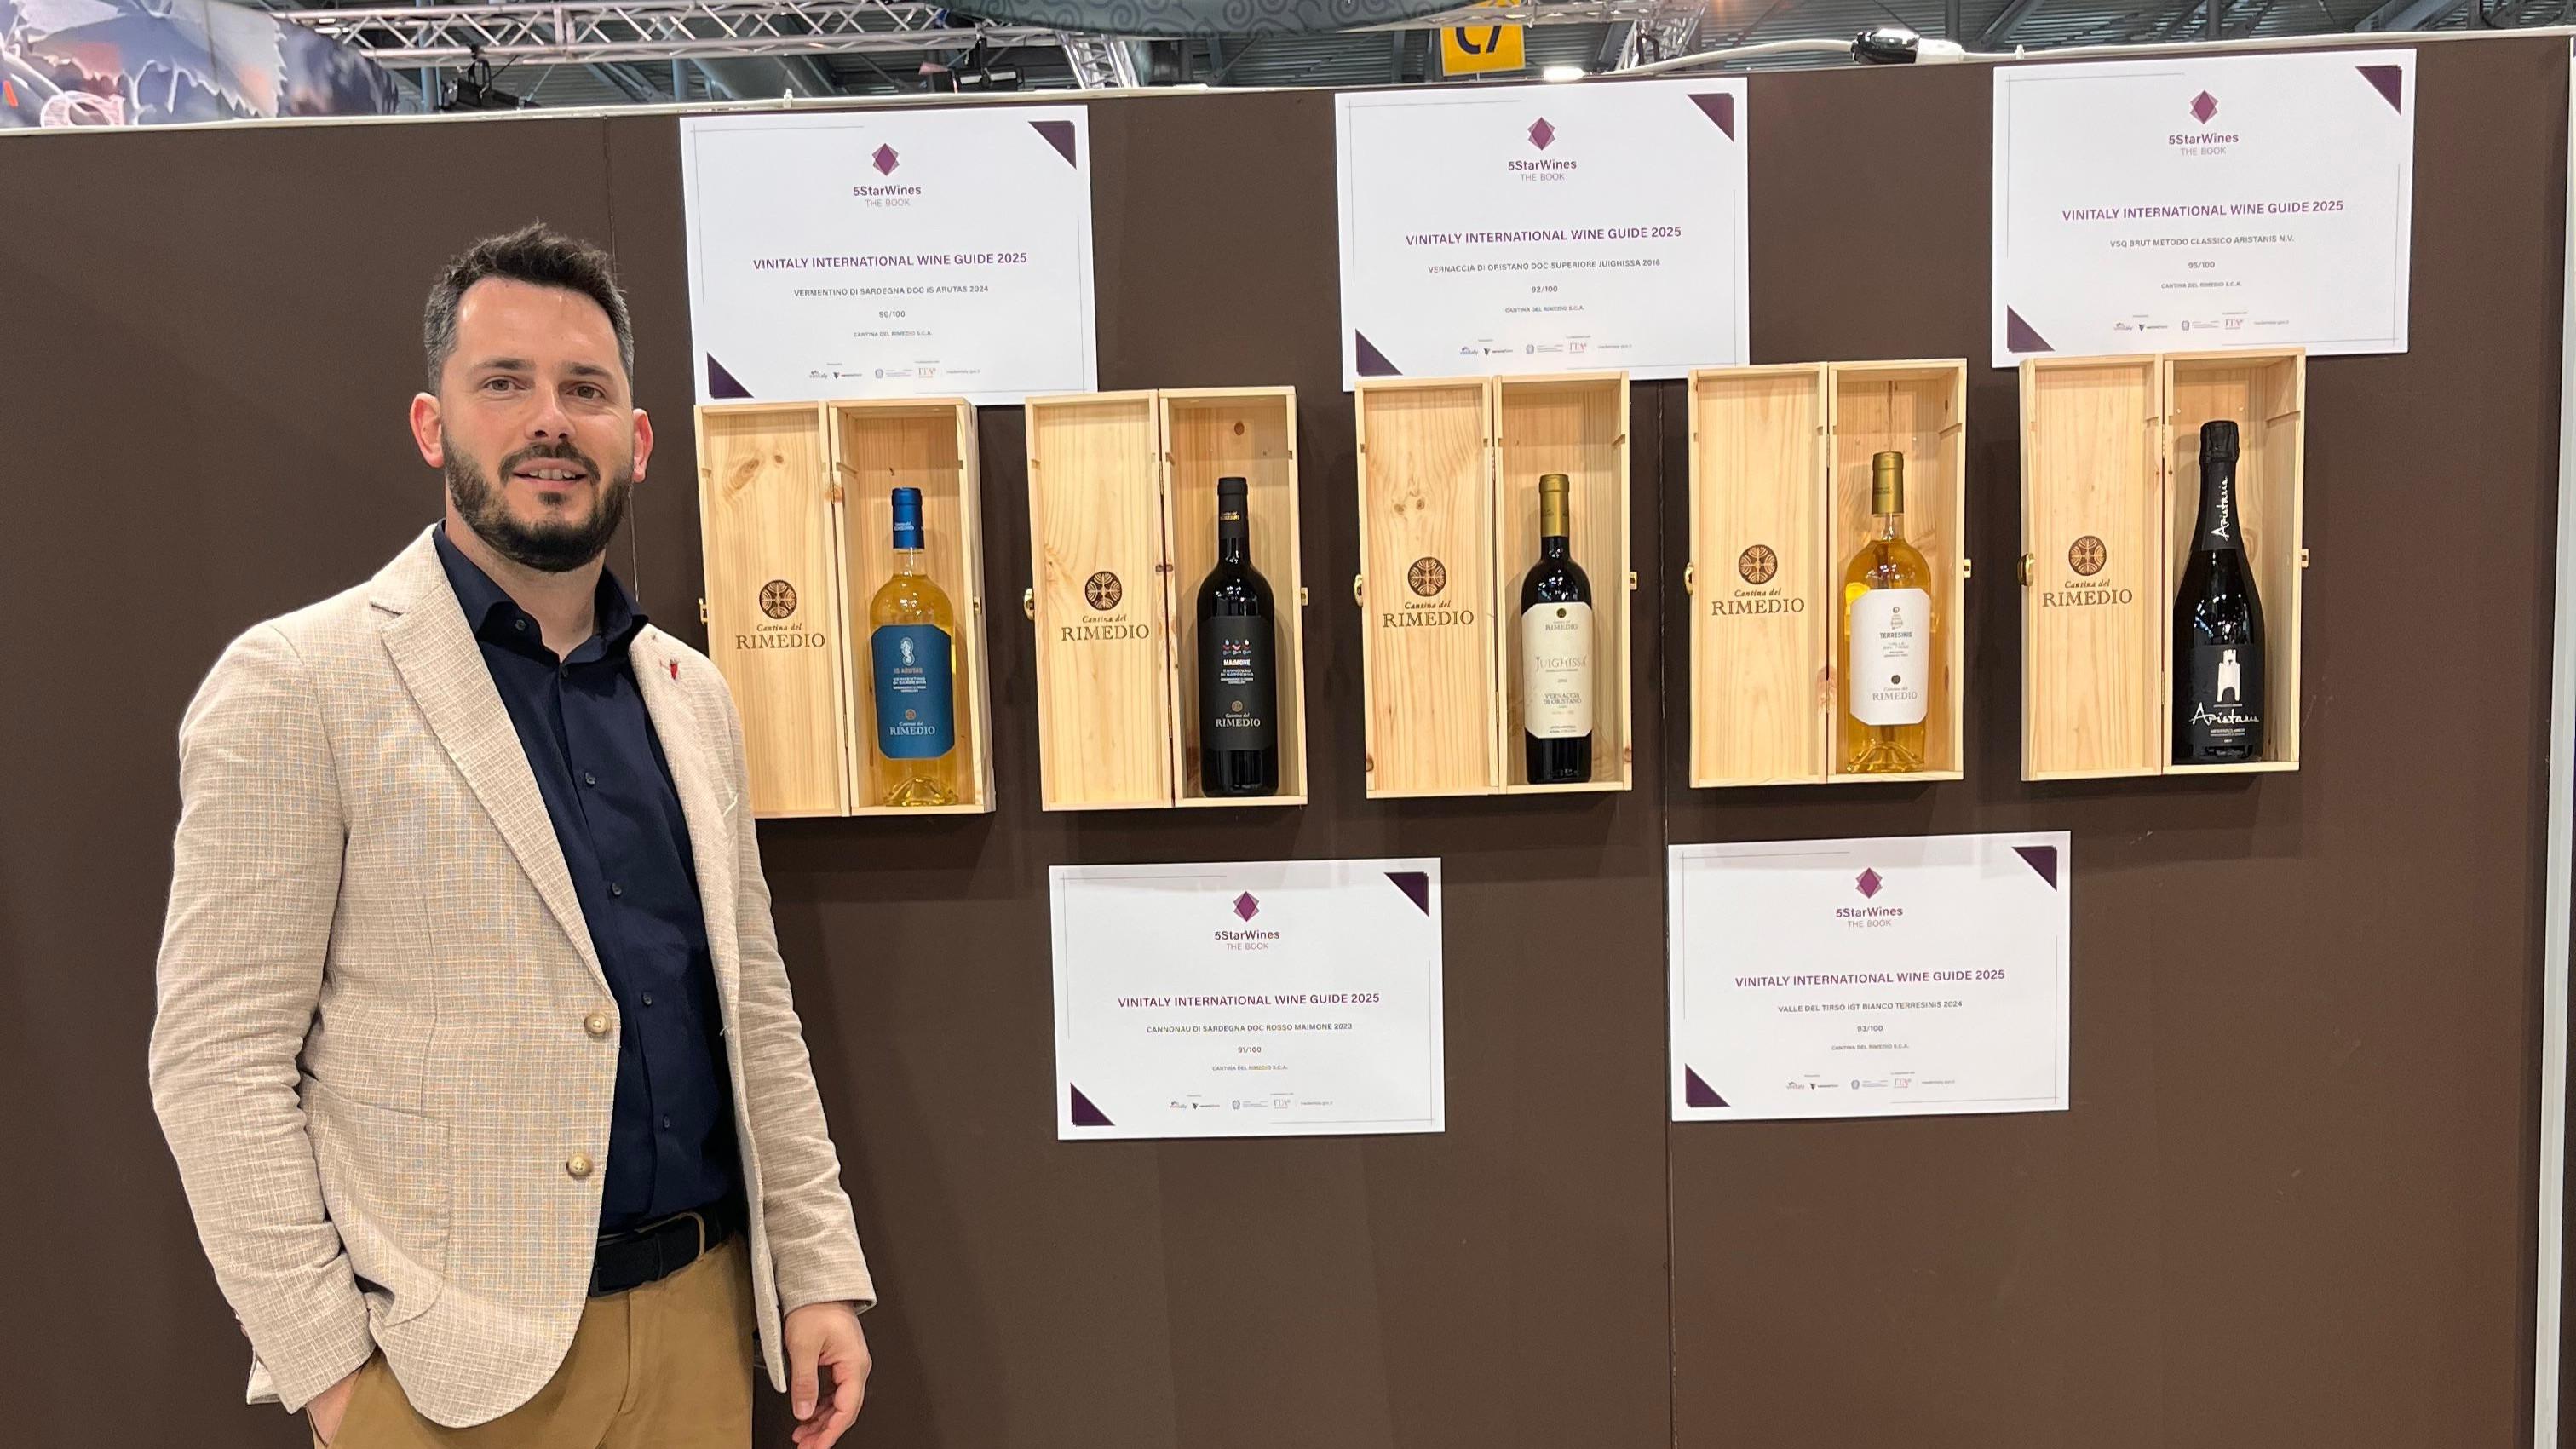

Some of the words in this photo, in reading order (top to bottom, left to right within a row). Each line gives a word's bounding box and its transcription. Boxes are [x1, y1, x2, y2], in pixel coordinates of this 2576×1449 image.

[2168, 133, 2240, 145] 5StarWines
[2180, 147, 2198, 157] THE
[2200, 146, 2227, 156] BOOK
[1508, 159, 1578, 171] 5StarWines
[1520, 173, 1537, 182] THE
[1539, 172, 1566, 181] BOOK
[853, 185, 922, 197] 5StarWines
[865, 198, 883, 208] THE
[885, 198, 911, 207] BOOK
[2061, 208, 2120, 221] VINITALY
[2123, 204, 2228, 219] INTERNATIONAL
[2230, 203, 2264, 216] WINE
[2268, 201, 2309, 214] GUIDE
[2312, 200, 2343, 212] 2025
[1406, 233, 1463, 246] VINITALY
[1465, 230, 1568, 244] INTERNATIONAL
[1570, 228, 1605, 240] WINE
[1607, 227, 1648, 239] GUIDE
[1651, 226, 1682, 238] 2025
[2109, 239, 2128, 249] VSQ
[2129, 239, 2152, 248] BRUT
[2153, 238, 2189, 246] METODO
[2190, 237, 2233, 245] CLASSICO
[2234, 234, 2277, 244] ARISTANIS
[2279, 234, 2295, 243] N.V.
[752, 258, 809, 270] VINITALY
[812, 256, 914, 268] INTERNATIONAL
[917, 254, 951, 266] WINE
[953, 253, 994, 265] GUIDE
[997, 252, 1027, 264] 2025
[1428, 264, 1475, 273] VERNACCIA
[1487, 262, 1529, 272] ORISTANO
[1531, 262, 1549, 270] DOC
[1550, 261, 1597, 269] SUPERIORE
[793, 288, 848, 297] VERMENTINO
[860, 287, 906, 296] SARDEGNA
[935, 285, 968, 294] ARUTAS
[2064, 580, 2096, 589] Cantina
[2098, 578, 2111, 587] del
[1734, 589, 1767, 597] Cantina
[1768, 587, 1782, 596] del
[2042, 589, 2133, 607] RIMEDIO
[1404, 601, 1436, 610] Cantina
[1438, 599, 1452, 608] del
[1711, 597, 1805, 616] RIMEDIO
[1082, 615, 1113, 624] Cantina
[1115, 613, 1127, 623] del
[1383, 610, 1475, 628] RIMEDIO
[756, 624, 788, 632] Cantina
[790, 622, 802, 631] del
[1061, 624, 1150, 641] RIMEDIO
[735, 632, 825, 650] RIMEDIO
[1872, 691, 1918, 702] RIMEDIO
[1215, 718, 1261, 728] RIMEDIO
[889, 726, 936, 736] RIMEDIO
[1836, 906, 1904, 918] 5StarWines
[1847, 920, 1864, 929] THE
[1866, 918, 1892, 928] BOOK
[1214, 929, 1280, 940] 5StarWines
[1226, 942, 1242, 951] THE
[1245, 942, 1268, 951] BOOK
[1734, 976, 1791, 987] VINITALY
[1793, 973, 1894, 986] INTERNATIONAL
[1896, 971, 1930, 982] WINE
[1932, 970, 1973, 981] GUIDE
[1975, 969, 2005, 980] 2025
[1118, 997, 1171, 1008] VINITALY
[1174, 995, 1272, 1007] INTERNATIONAL
[1274, 994, 1307, 1005] WINE
[1309, 993, 1348, 1004] GUIDE
[1351, 992, 1380, 1003] 2025
[1778, 1004, 1803, 1013] VALLE
[1804, 1004, 1820, 1013] DEL
[1821, 1003, 1846, 1012] TIRSO
[1847, 1003, 1861, 1011] IGT
[1862, 1002, 1894, 1010] BIANCO
[1193, 1025, 1201, 1033] DI
[1266, 1023, 1293, 1032] ROSSO
